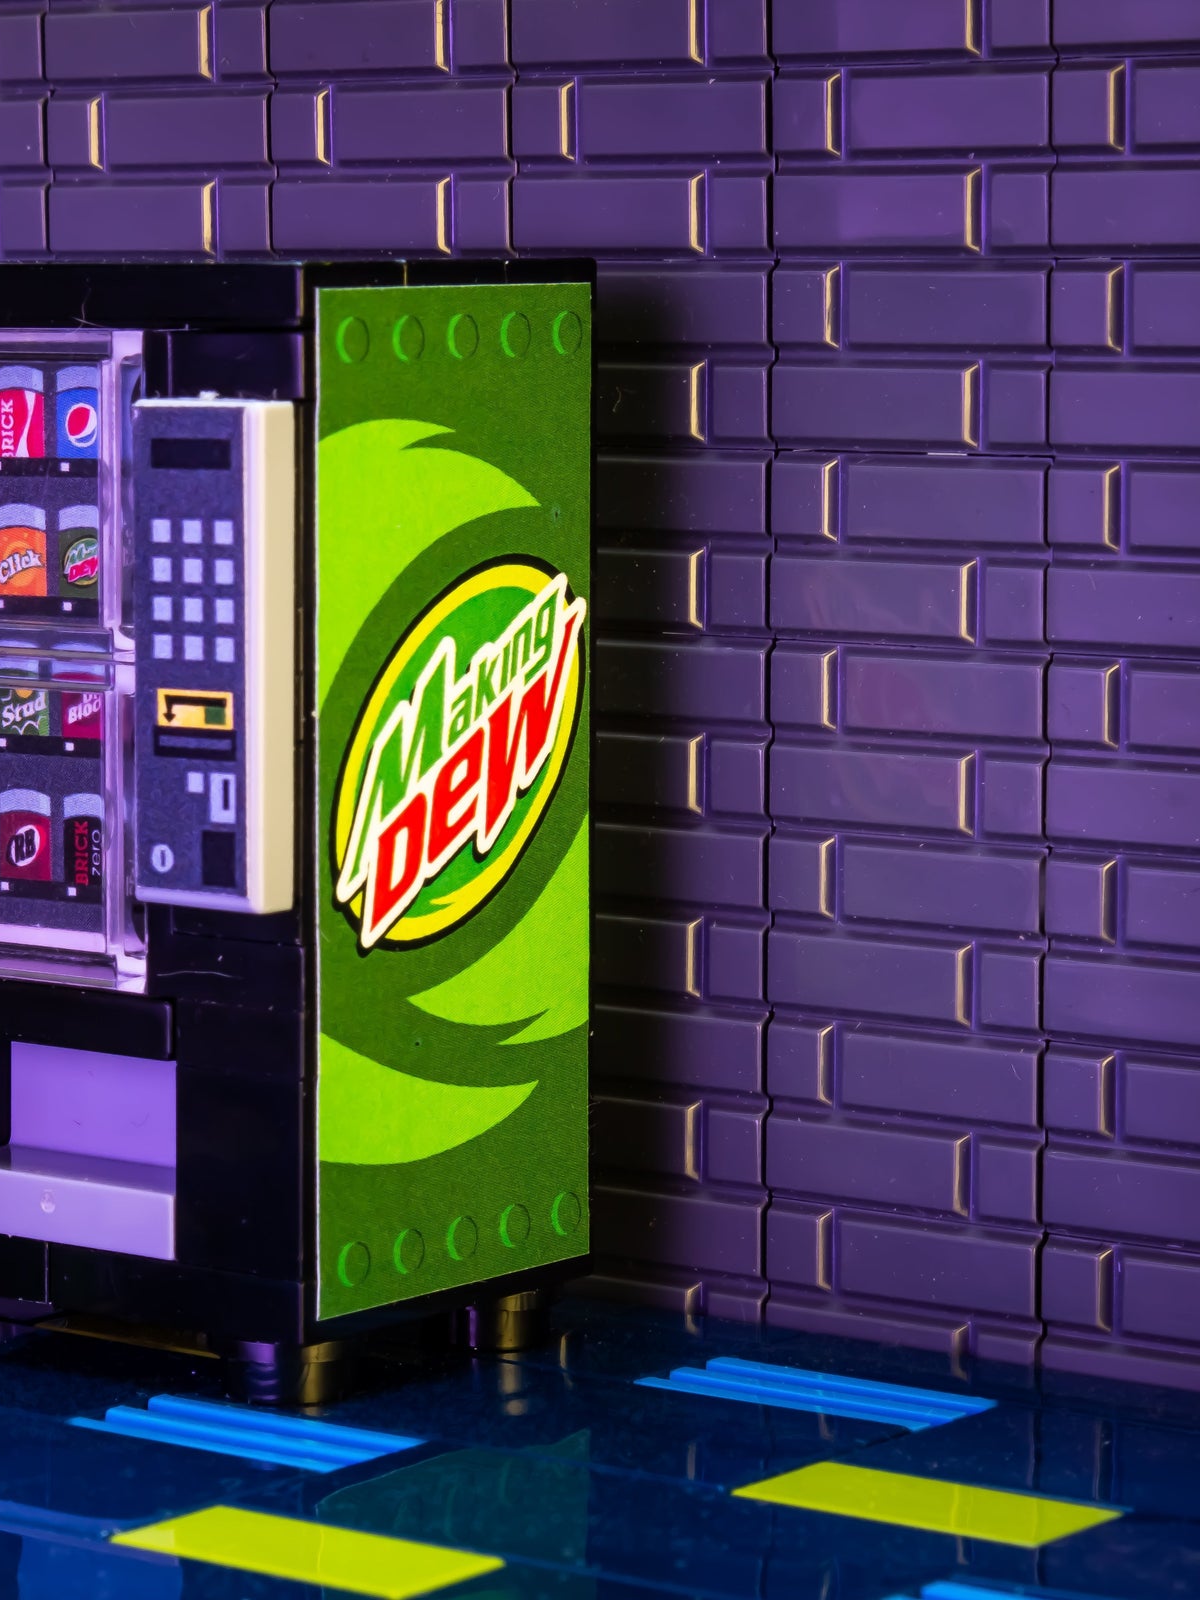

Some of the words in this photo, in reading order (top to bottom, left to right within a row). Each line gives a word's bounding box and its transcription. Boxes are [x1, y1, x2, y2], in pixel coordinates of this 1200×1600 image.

[2, 691, 47, 728] Stud
[343, 586, 561, 890] Making
[74, 820, 89, 886] BRICK
[91, 829, 101, 876] zero
